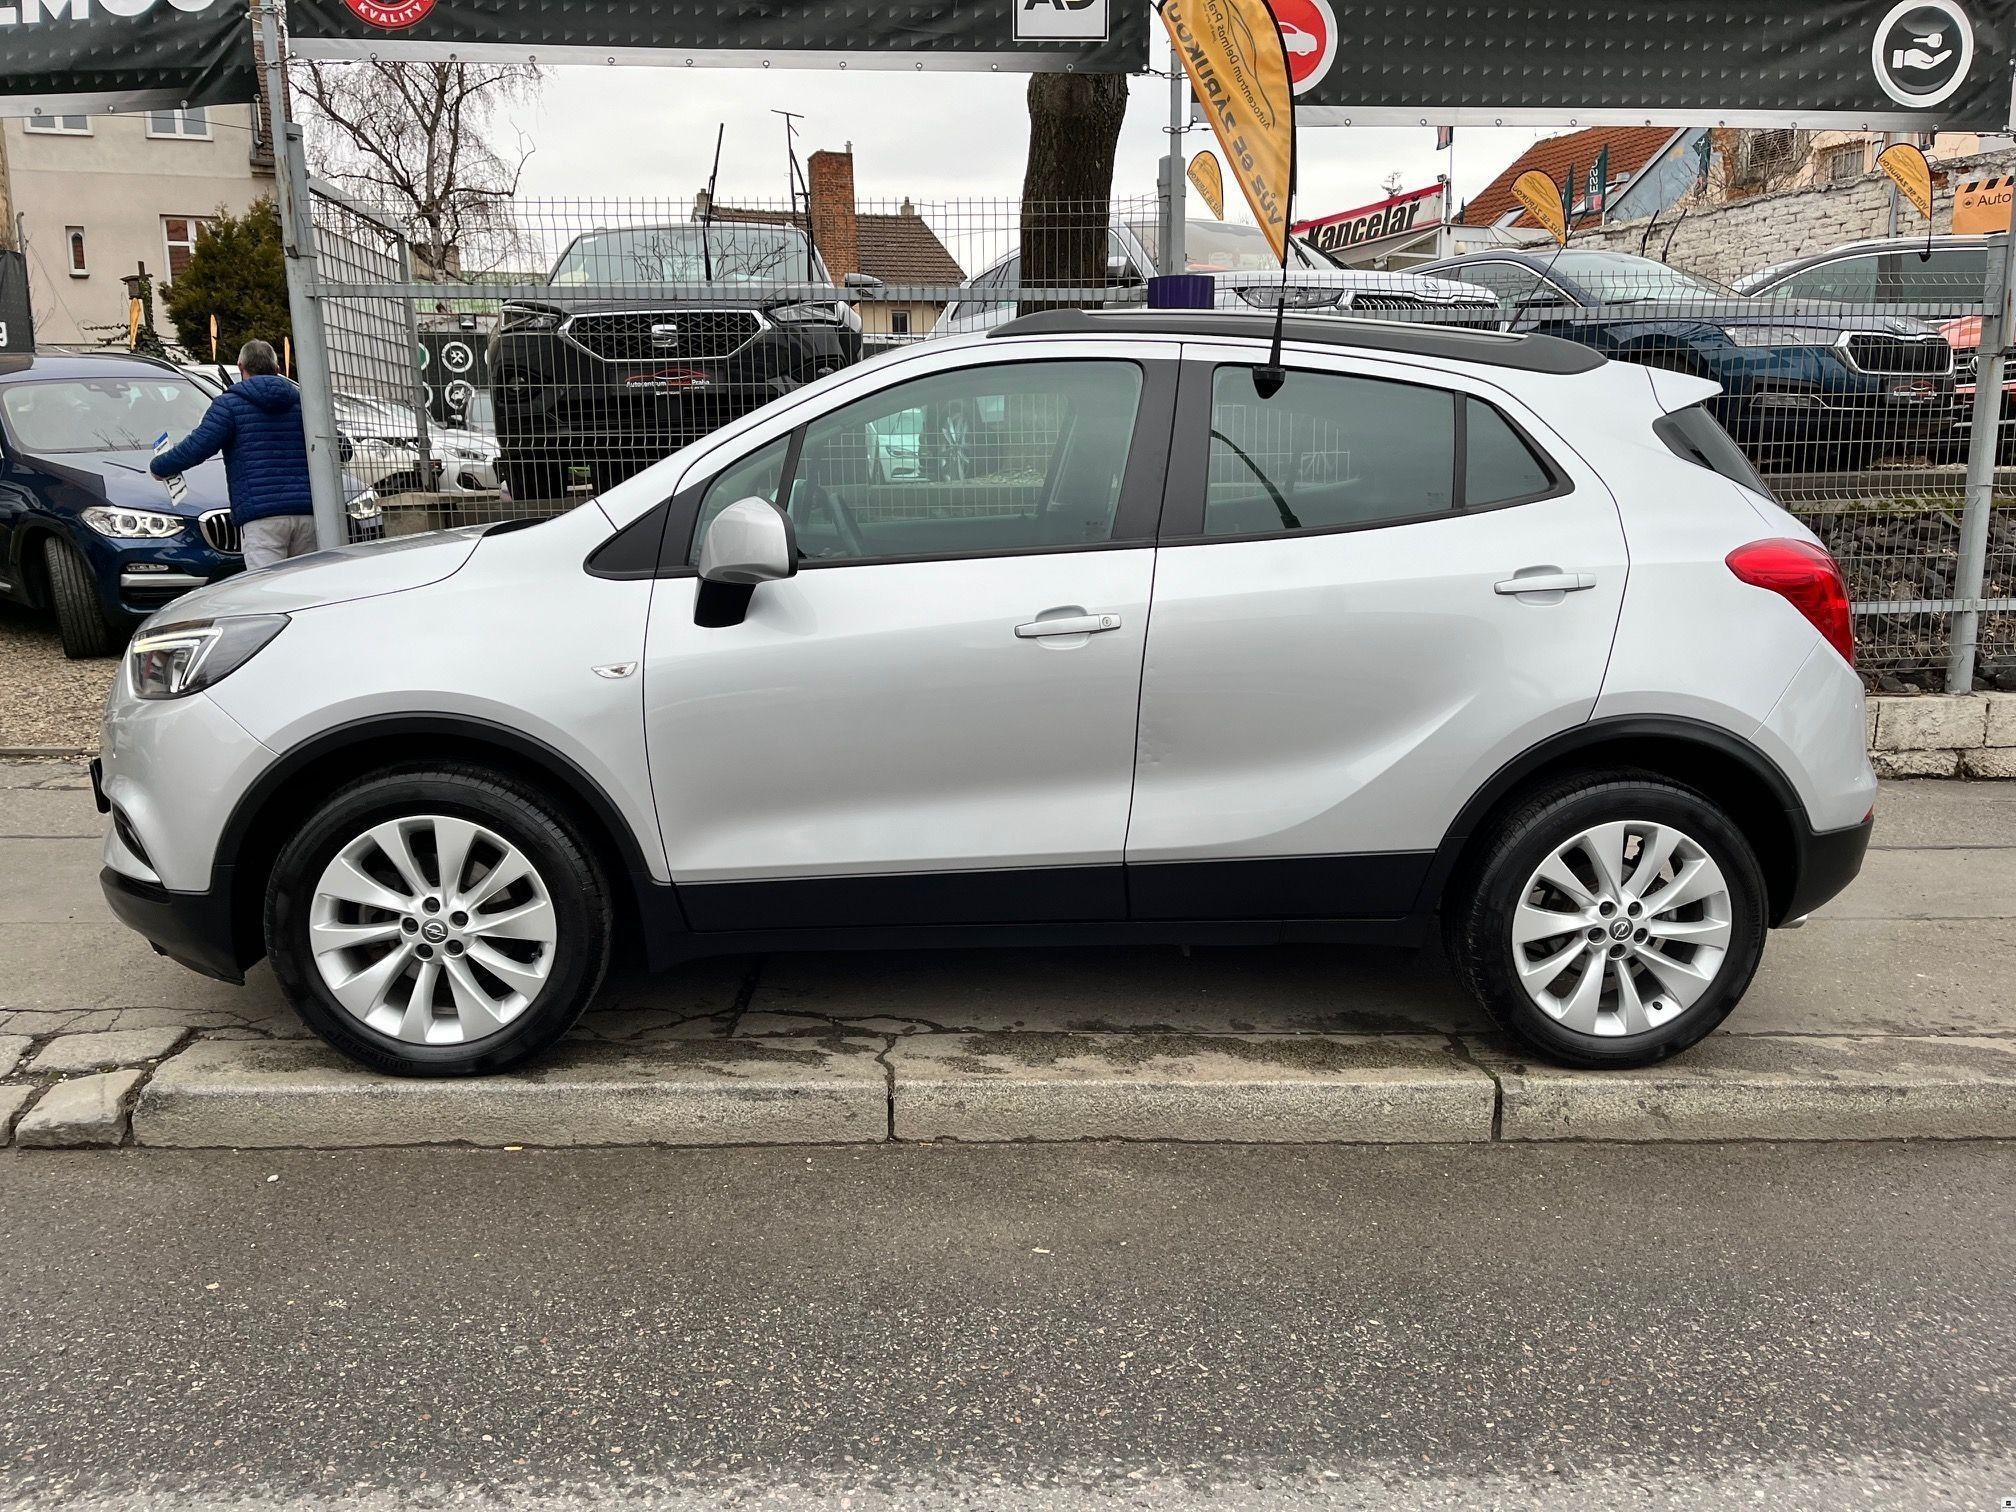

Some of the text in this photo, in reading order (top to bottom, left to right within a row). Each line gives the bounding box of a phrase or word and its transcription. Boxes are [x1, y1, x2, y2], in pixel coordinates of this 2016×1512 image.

[358, 2, 422, 22] KVALITY
[1977, 192, 2012, 207] Auto
[1308, 195, 1421, 251] Kancelář
